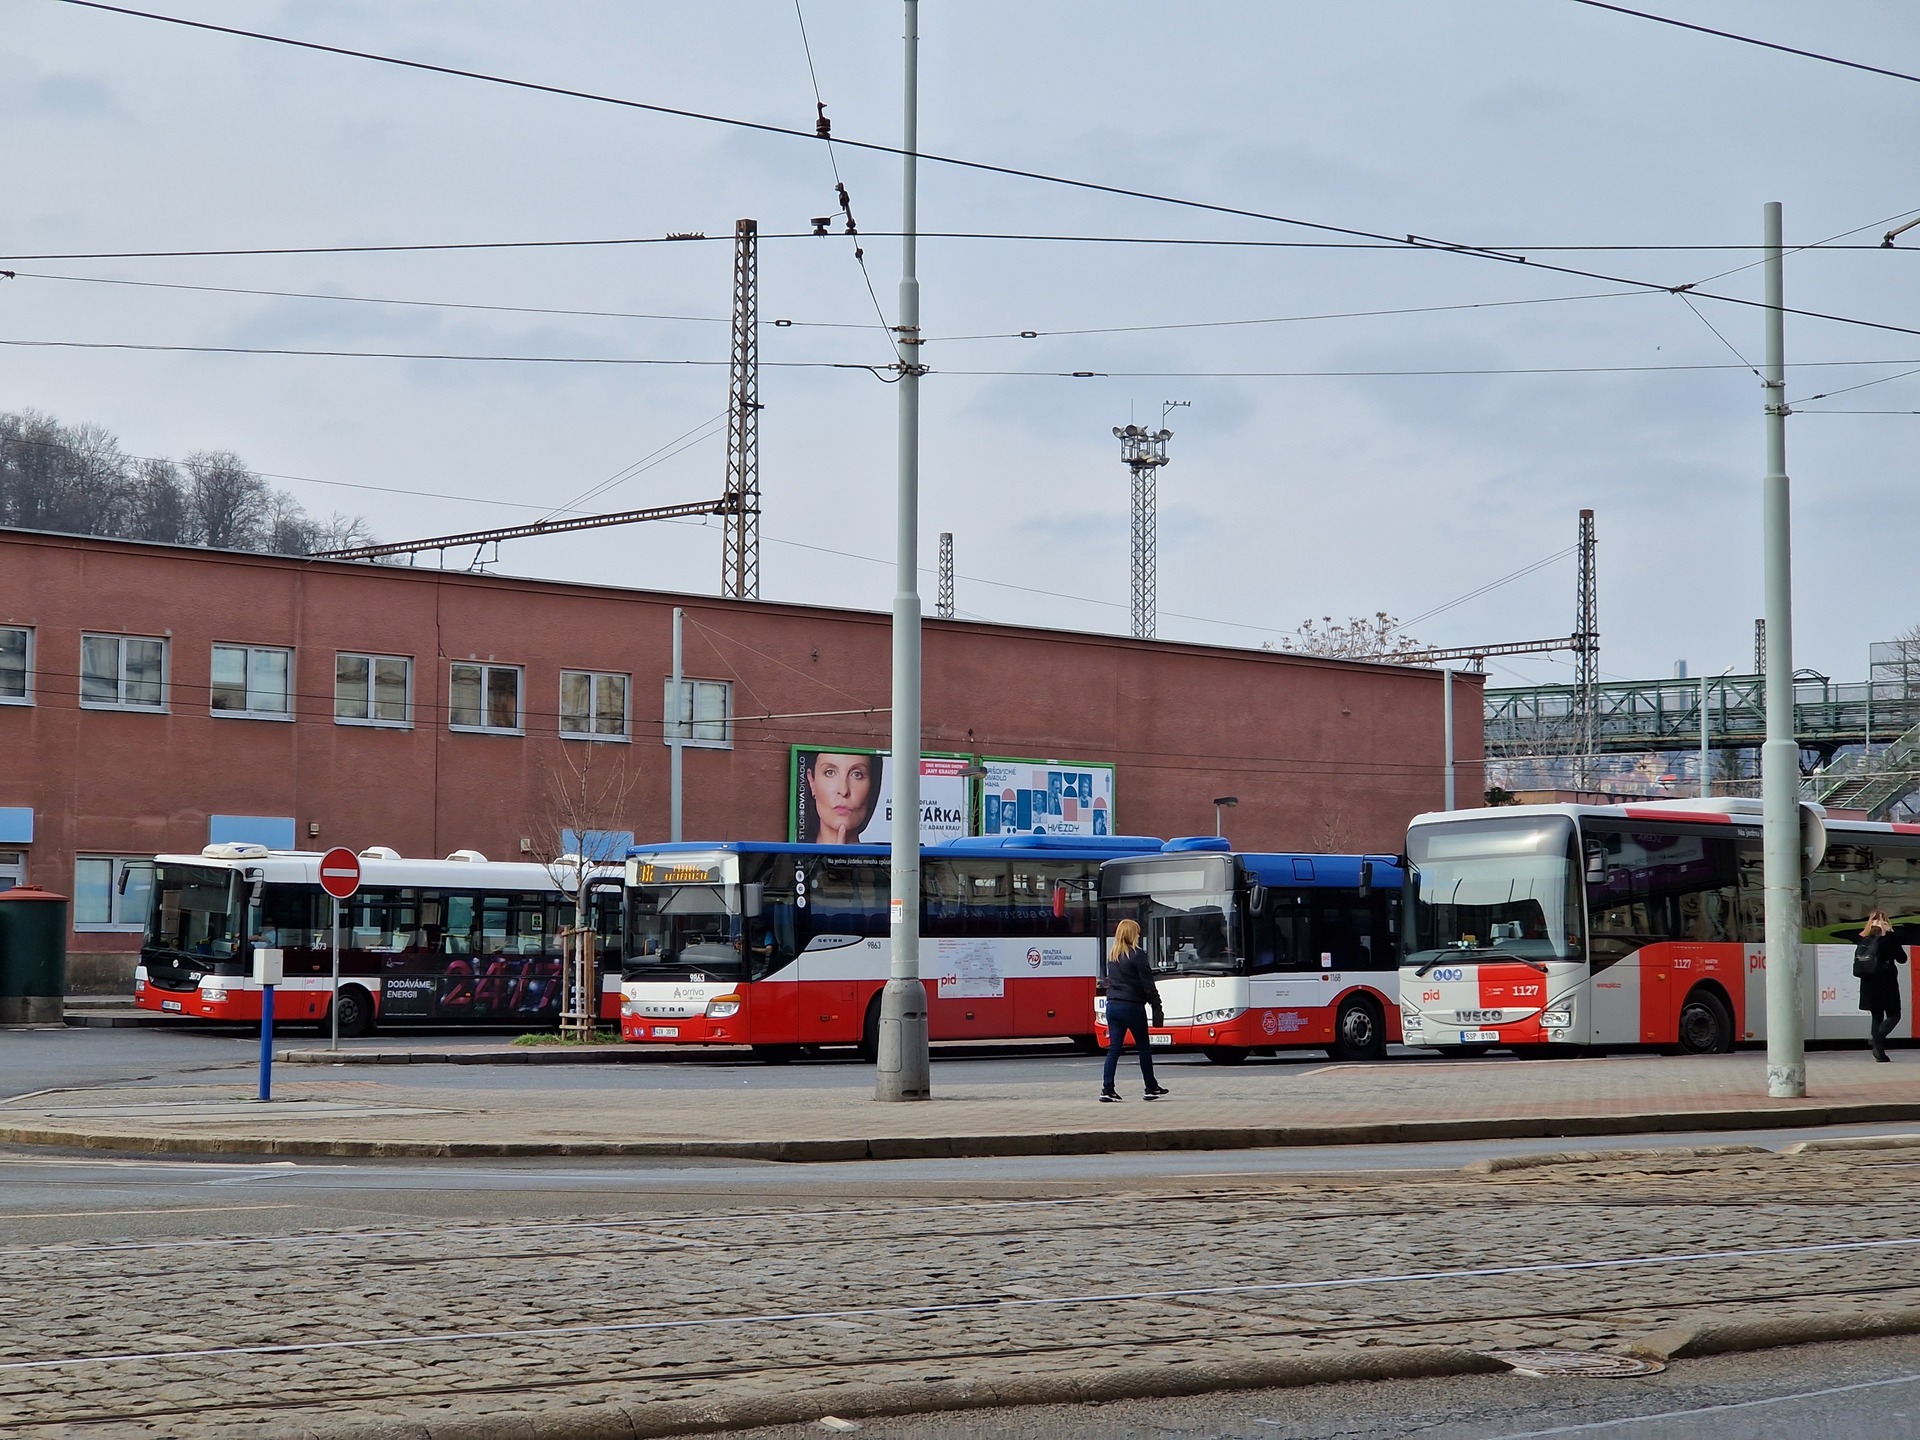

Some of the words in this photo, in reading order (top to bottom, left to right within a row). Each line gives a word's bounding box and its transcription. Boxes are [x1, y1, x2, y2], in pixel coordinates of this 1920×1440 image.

[1048, 820, 1080, 832] HVĚZDY
[867, 941, 881, 949] 9863
[1674, 959, 1691, 969] 1127
[689, 973, 705, 982] 9863
[941, 973, 957, 988] pid
[387, 978, 431, 989] DODÁVÁME
[1199, 980, 1216, 988] 1168
[387, 990, 417, 998] ENERGII
[1512, 985, 1539, 996] 1127
[1821, 986, 1836, 1004] pid
[1422, 989, 1440, 1004] pid
[1456, 1010, 1503, 1022] IVECO
